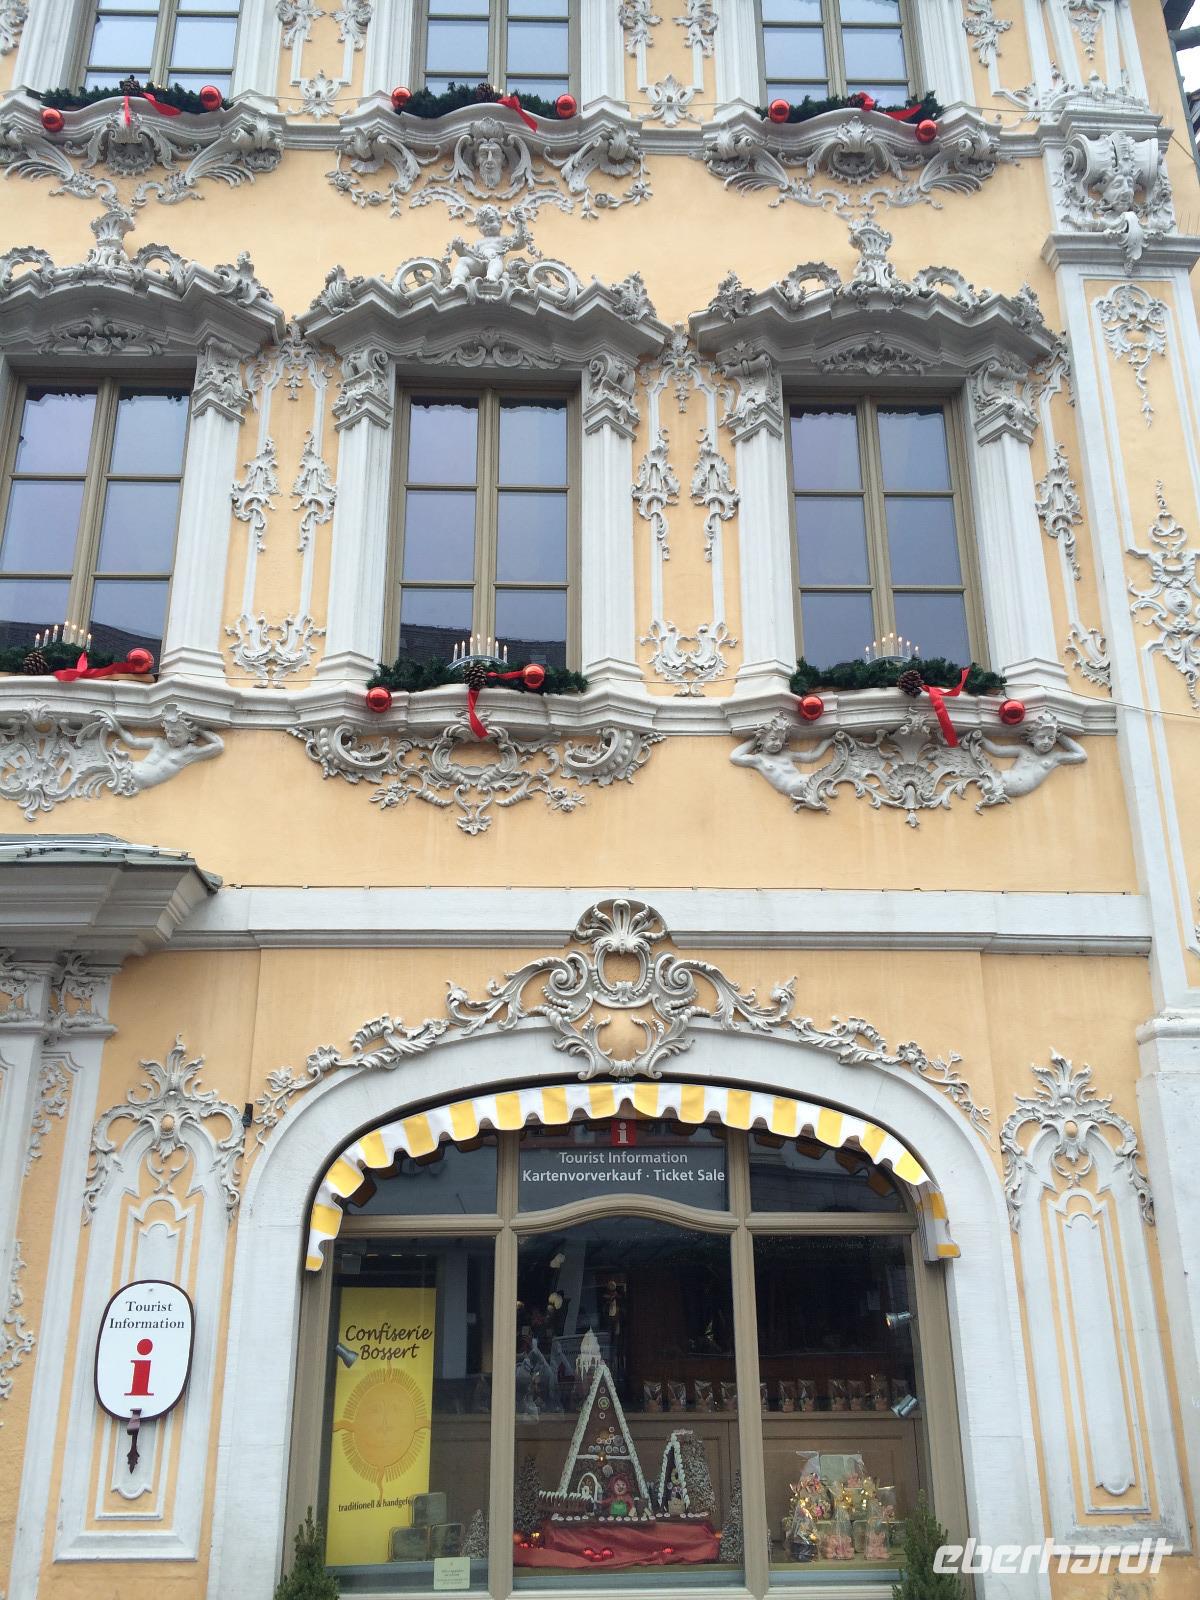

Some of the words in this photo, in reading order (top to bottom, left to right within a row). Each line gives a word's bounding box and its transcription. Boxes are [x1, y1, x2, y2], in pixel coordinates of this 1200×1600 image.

[559, 1152, 604, 1164] Tourist
[609, 1151, 688, 1164] Information
[522, 1169, 642, 1182] Kartenvorverkauf
[653, 1169, 694, 1182] Ticket
[697, 1169, 725, 1182] Sale
[126, 1301, 173, 1312] Tourist
[109, 1318, 185, 1329] Information
[345, 1322, 433, 1344] Confiserie
[360, 1343, 420, 1360] Bossert
[338, 1500, 375, 1512] traditionell
